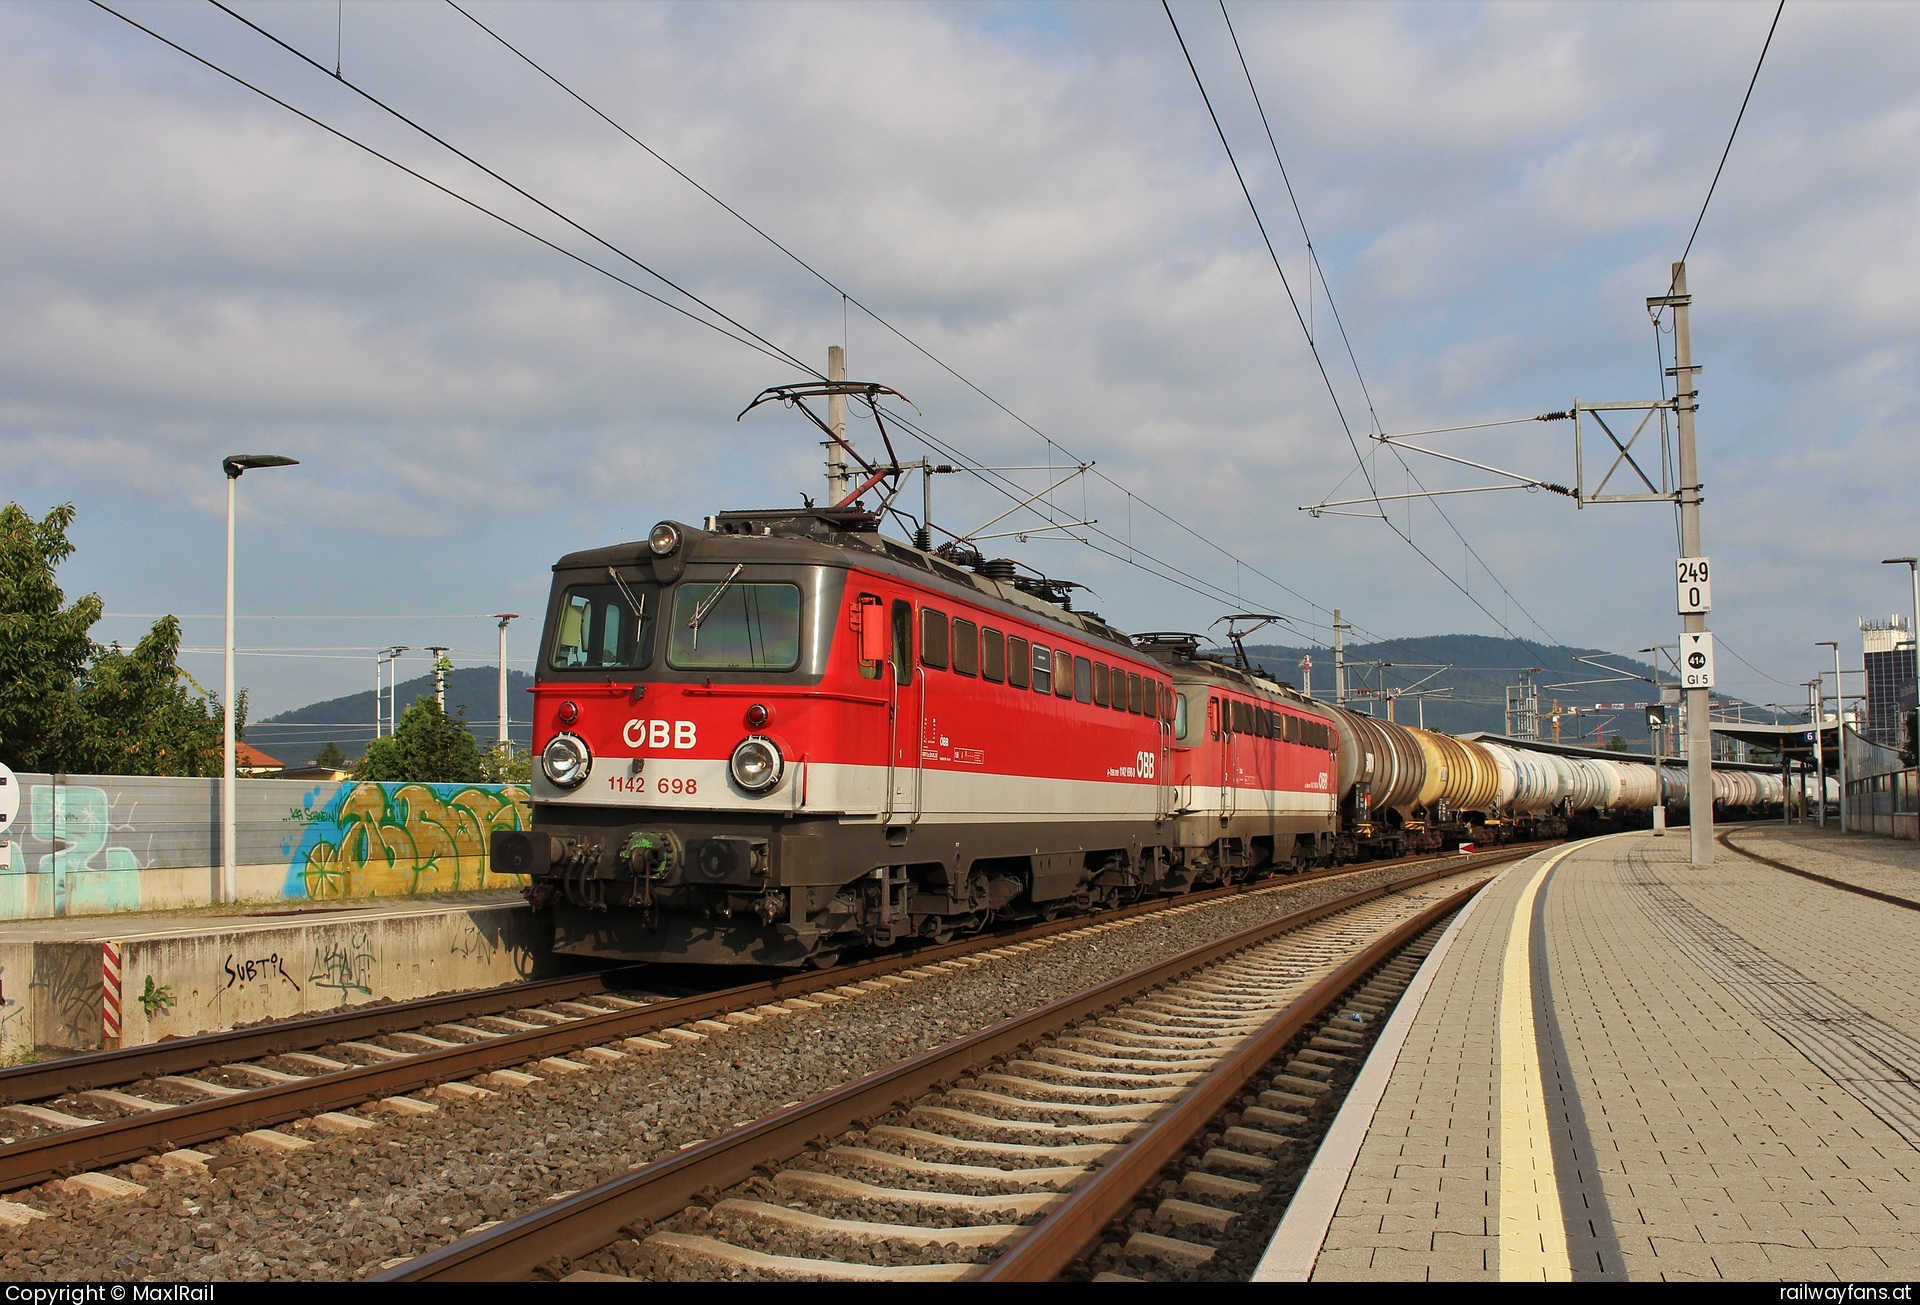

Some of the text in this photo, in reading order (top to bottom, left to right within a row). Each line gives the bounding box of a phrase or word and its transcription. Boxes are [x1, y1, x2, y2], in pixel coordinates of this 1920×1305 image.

[1678, 561, 1709, 584] 249
[1688, 586, 1701, 607] 0
[1689, 655, 1705, 666] 414
[1702, 674, 1709, 685] 5
[622, 718, 697, 750] ÖBB
[1806, 732, 1813, 741] 6
[1136, 750, 1155, 779] ÖBB
[608, 776, 697, 795] 1142 698
